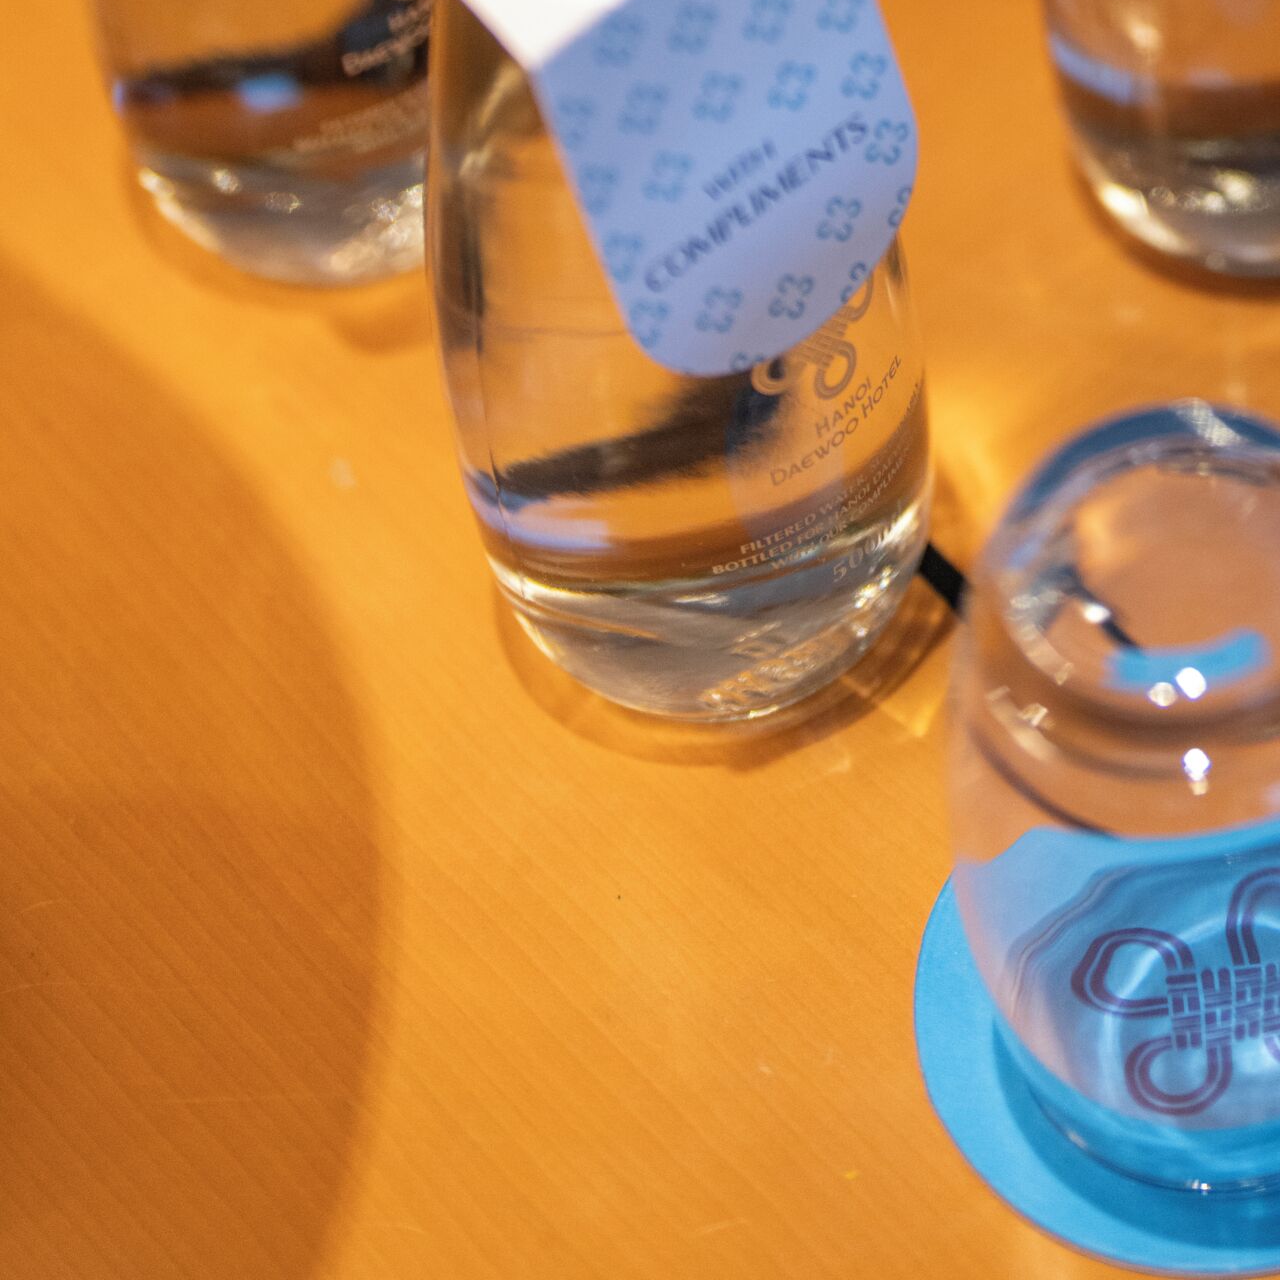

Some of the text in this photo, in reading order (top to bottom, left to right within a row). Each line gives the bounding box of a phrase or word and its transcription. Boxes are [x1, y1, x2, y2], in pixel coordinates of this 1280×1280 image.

[769, 416, 859, 487] DAEWOO
[861, 354, 903, 419] HOTEL
[815, 376, 872, 438] HANOI
[711, 539, 793, 576] BOTTLED
[739, 513, 817, 555] FILTERED
